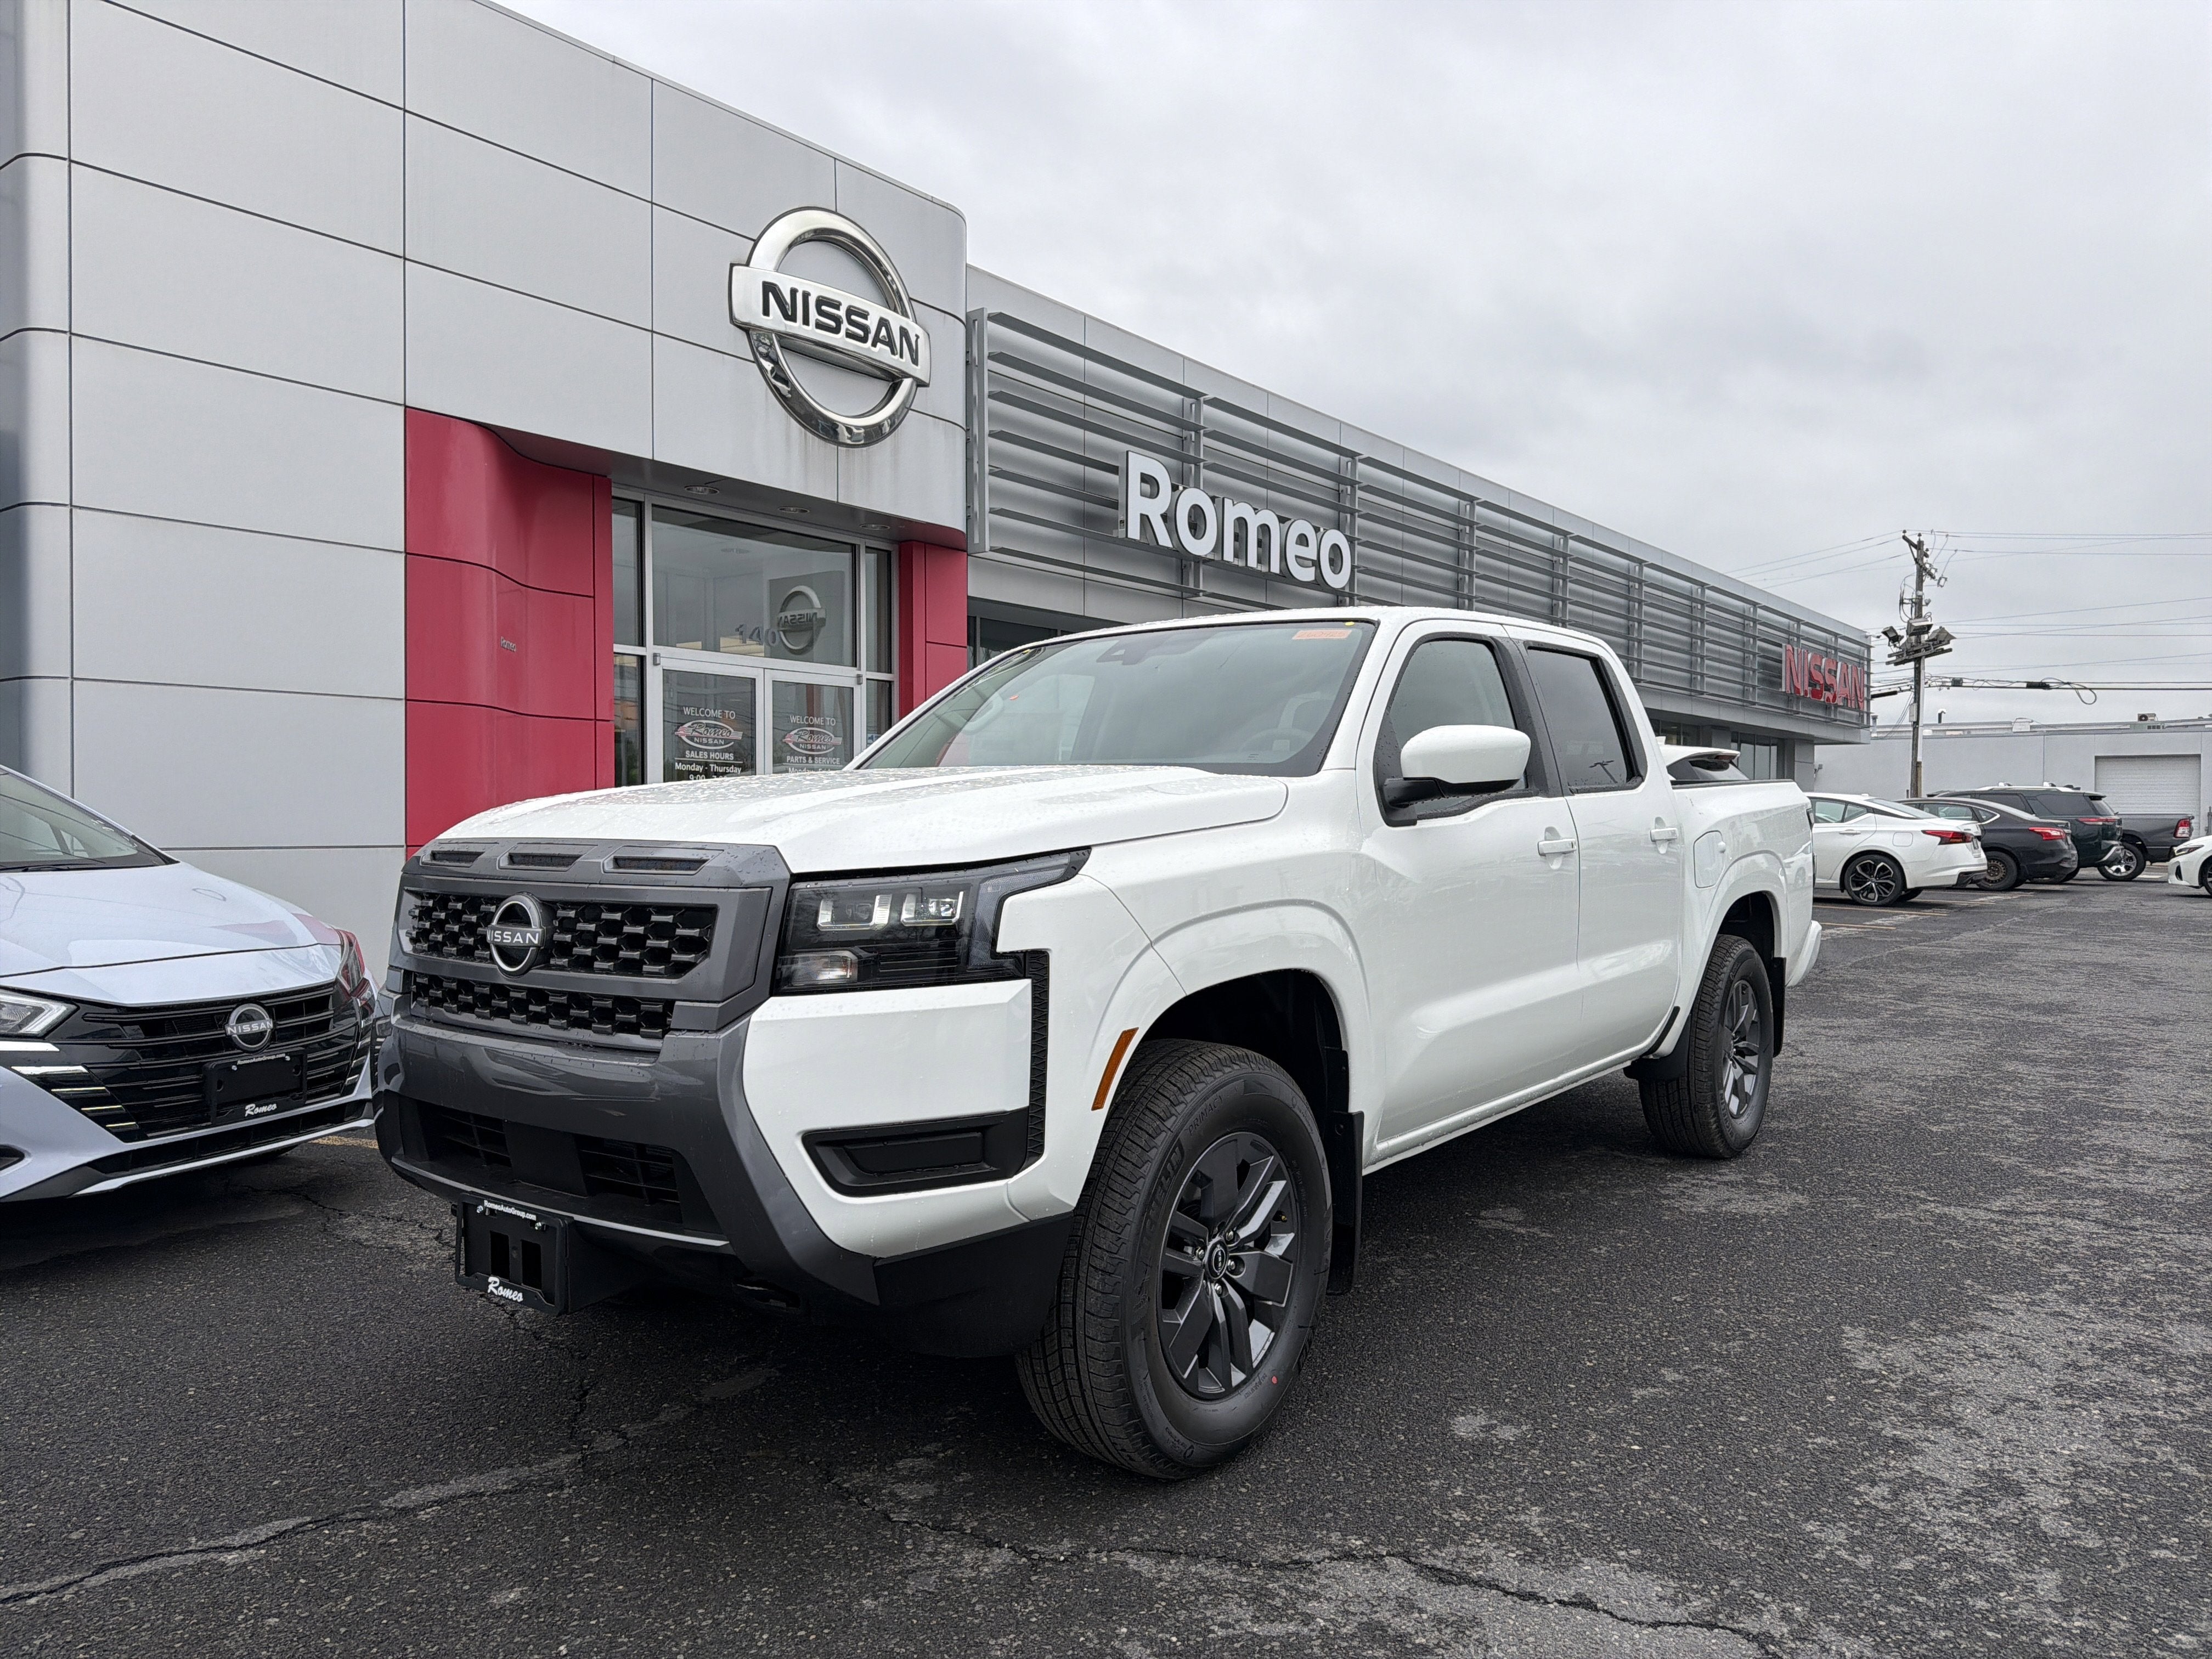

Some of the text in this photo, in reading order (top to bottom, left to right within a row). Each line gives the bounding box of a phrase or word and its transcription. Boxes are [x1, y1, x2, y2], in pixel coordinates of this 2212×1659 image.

[762, 280, 920, 368] NISSAN
[1126, 450, 1351, 589] Romeo
[1784, 644, 1864, 711] NISSAN
[683, 707, 736, 719] WELCOME TO
[790, 715, 836, 726] WELCOME TO
[687, 721, 732, 737] Romeo
[795, 729, 833, 743] Romeo
[685, 751, 734, 760] SALES HOURS
[675, 762, 704, 773] Monday
[709, 764, 742, 775] Thursday
[487, 929, 539, 944] NISSAN
[227, 1021, 273, 1035] NISSAN
[237, 1053, 286, 1065] RomeoAutoGroup.com
[245, 1103, 277, 1117] Romeo
[483, 1200, 537, 1221] RomeoAutoGroup.com
[487, 1276, 523, 1302] Romeo
